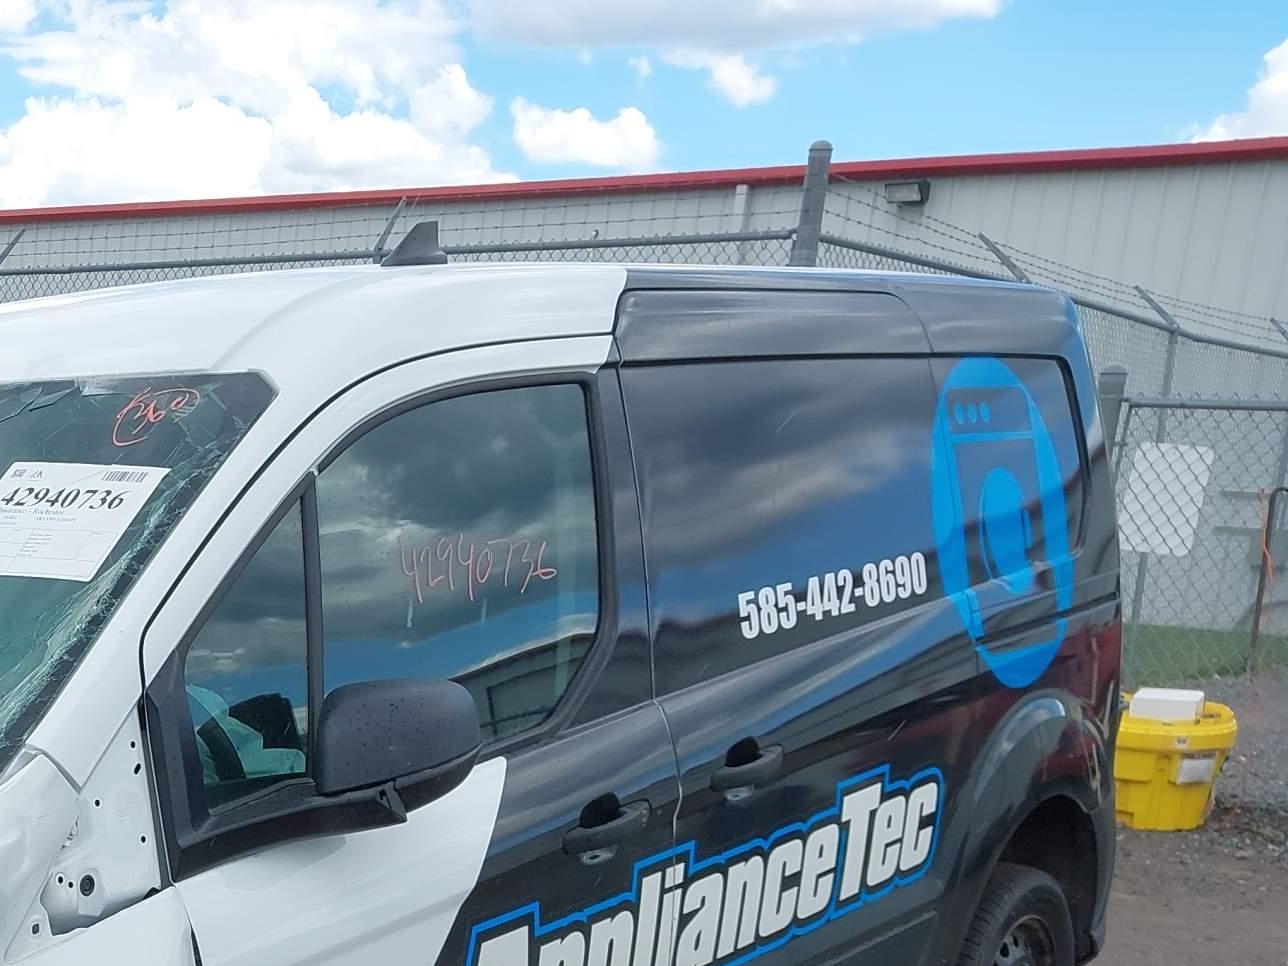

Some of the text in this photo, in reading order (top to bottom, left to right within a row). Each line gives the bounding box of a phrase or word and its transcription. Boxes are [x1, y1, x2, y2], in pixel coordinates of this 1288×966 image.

[1, 487, 132, 510] 42940736
[401, 533, 557, 603] 42940736
[737, 551, 928, 640] 585-442-8690
